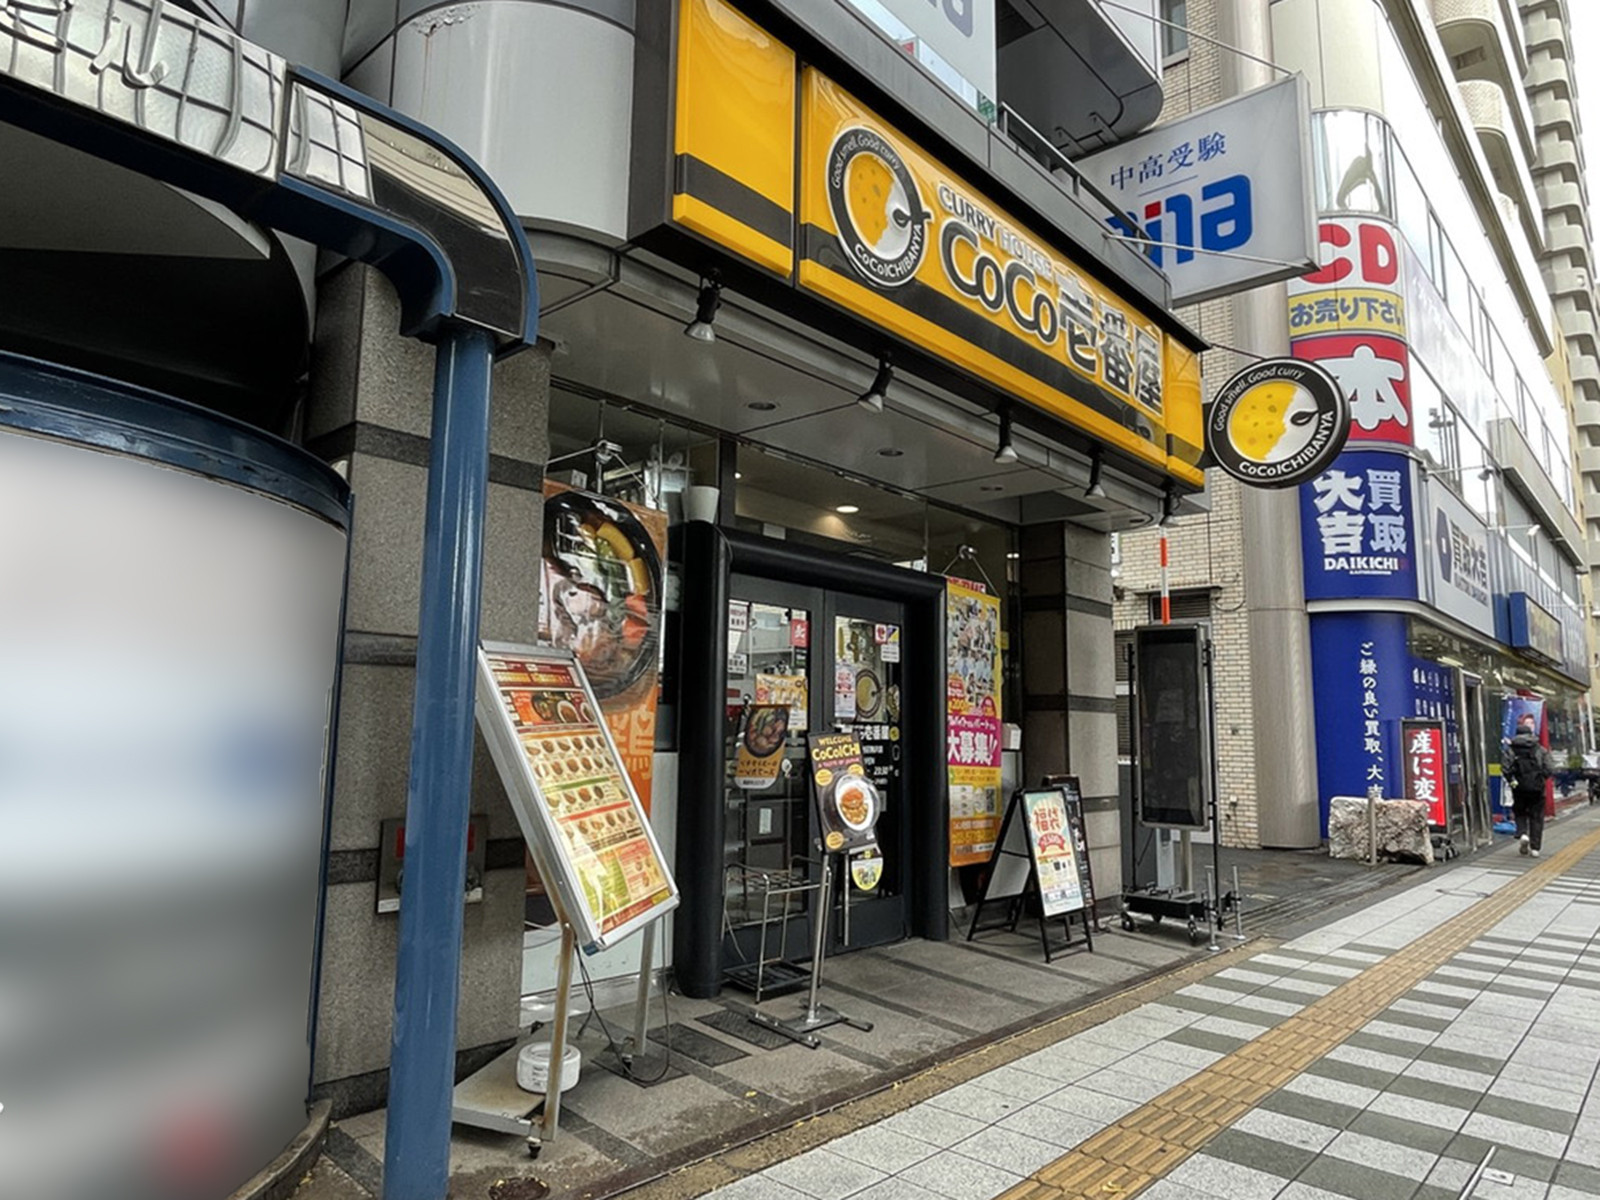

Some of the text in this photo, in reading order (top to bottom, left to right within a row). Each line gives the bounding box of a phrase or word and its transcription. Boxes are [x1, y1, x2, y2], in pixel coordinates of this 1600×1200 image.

[831, 155, 844, 189] Good
[1110, 132, 1226, 190] 中高受験
[938, 181, 1054, 285] CURRY HOUSE
[1300, 223, 1398, 285] CD
[938, 217, 1163, 418] CoCo壱番屋
[1213, 366, 1305, 432] Good smell. Good curry
[1314, 344, 1409, 430] 本
[1239, 410, 1335, 477] CoCoICHIBANYA
[1312, 468, 1366, 555] 大吉
[1366, 468, 1407, 554] 買取
[1323, 556, 1399, 571] DAIKICHI
[818, 735, 853, 746] WELCOME
